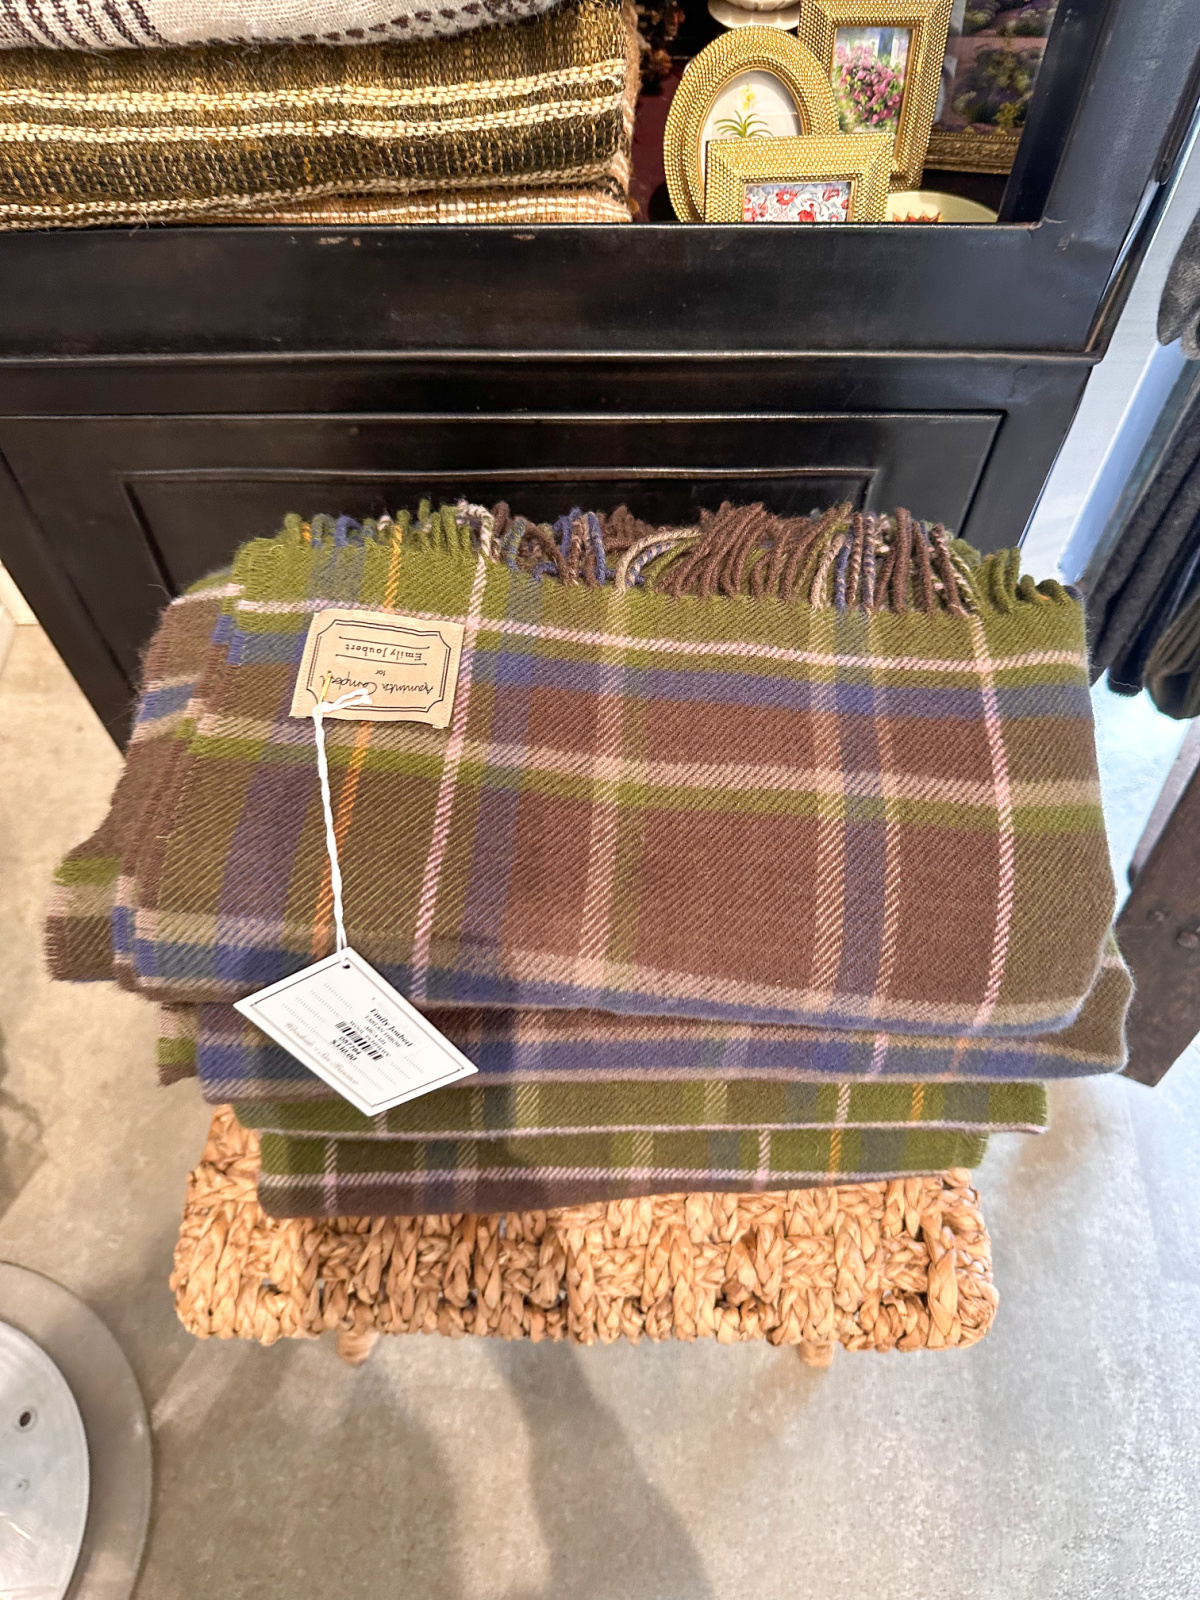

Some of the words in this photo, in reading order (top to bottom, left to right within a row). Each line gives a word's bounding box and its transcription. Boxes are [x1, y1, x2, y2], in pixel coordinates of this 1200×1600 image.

[344, 643, 387, 659] Joubert
[389, 649, 423, 662] Emily
[319, 671, 378, 696] Campbel
[370, 1008, 389, 1026] Emily
[386, 1025, 413, 1047] Joubert
